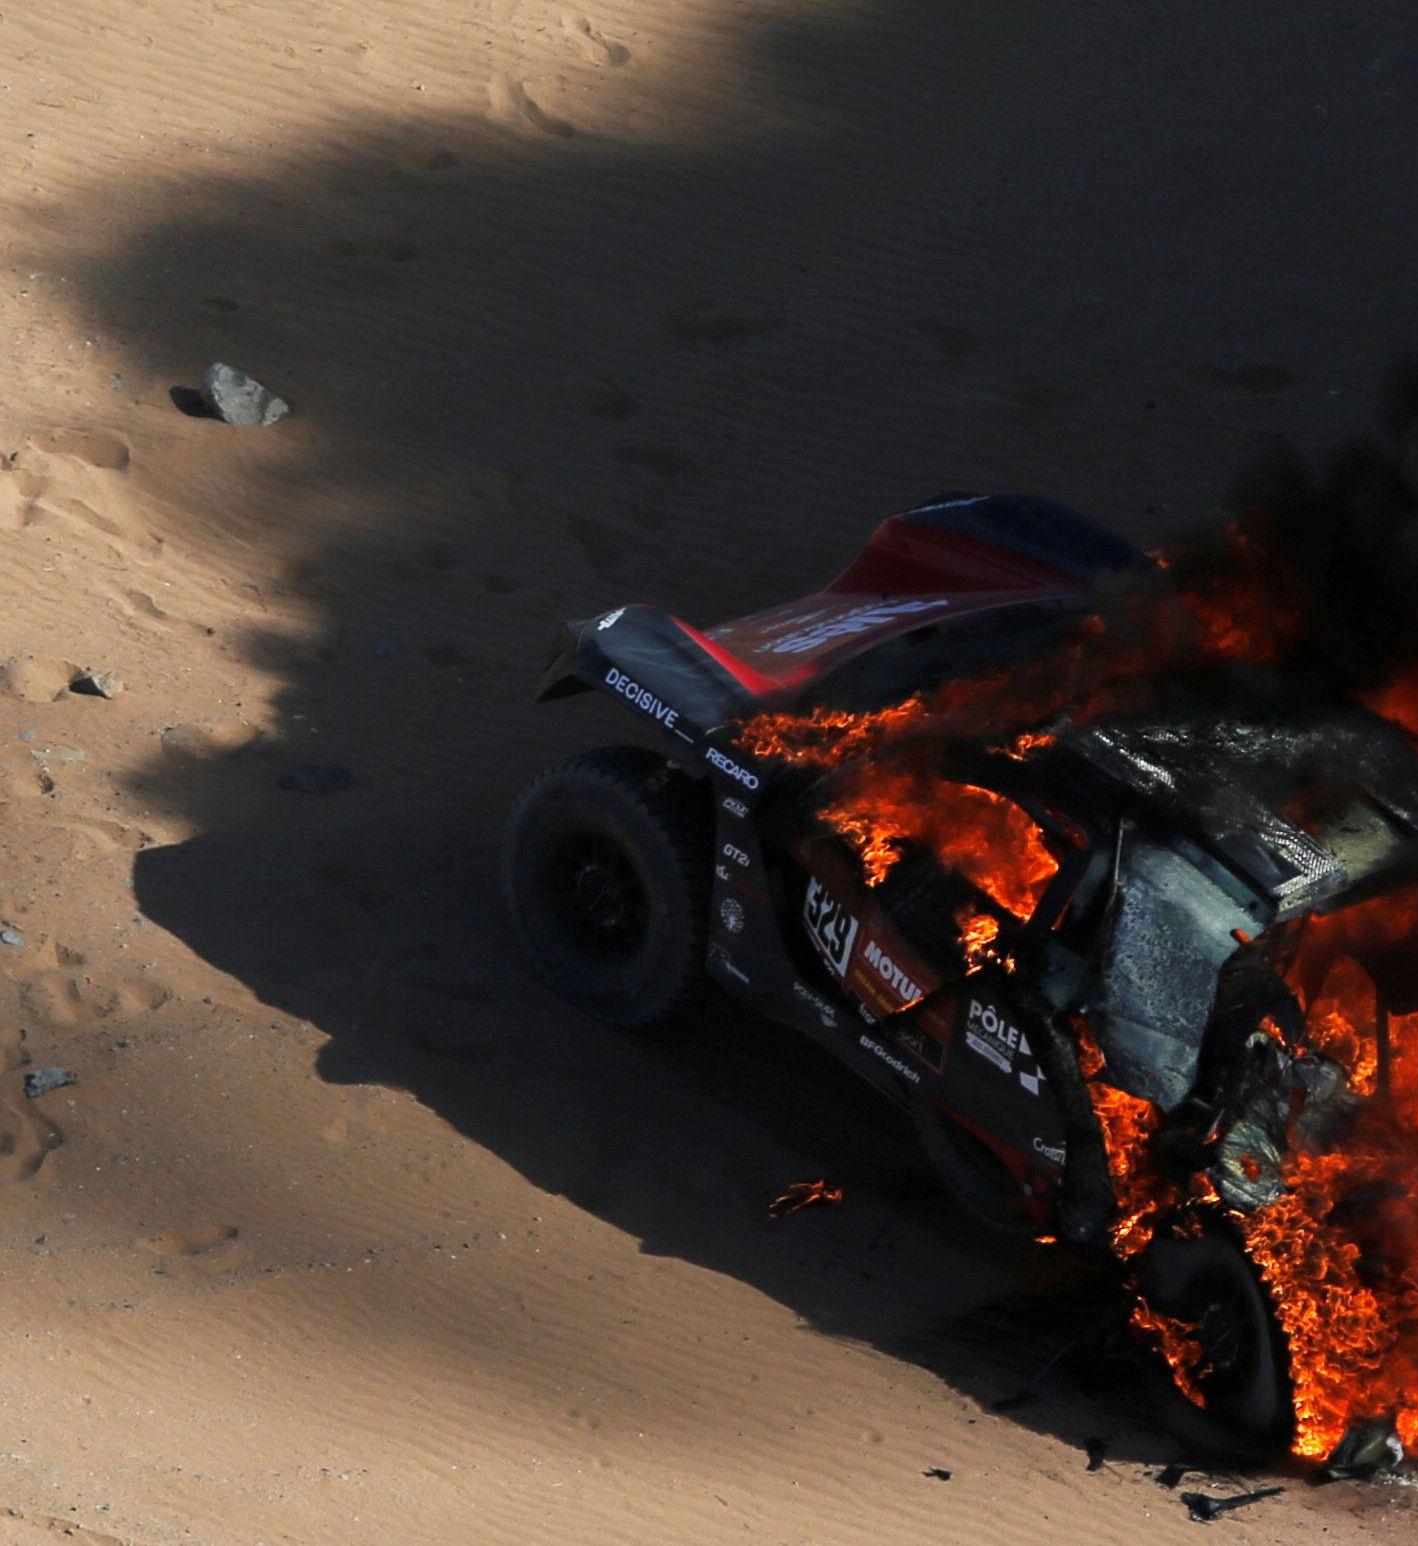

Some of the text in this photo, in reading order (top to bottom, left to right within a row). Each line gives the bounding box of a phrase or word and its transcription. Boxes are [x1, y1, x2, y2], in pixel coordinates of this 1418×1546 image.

[605, 667, 680, 729] DECISIVE
[706, 746, 760, 791] RECARO
[969, 998, 1019, 1049] PÔLE
[859, 1034, 921, 1085] BFGoodrich
